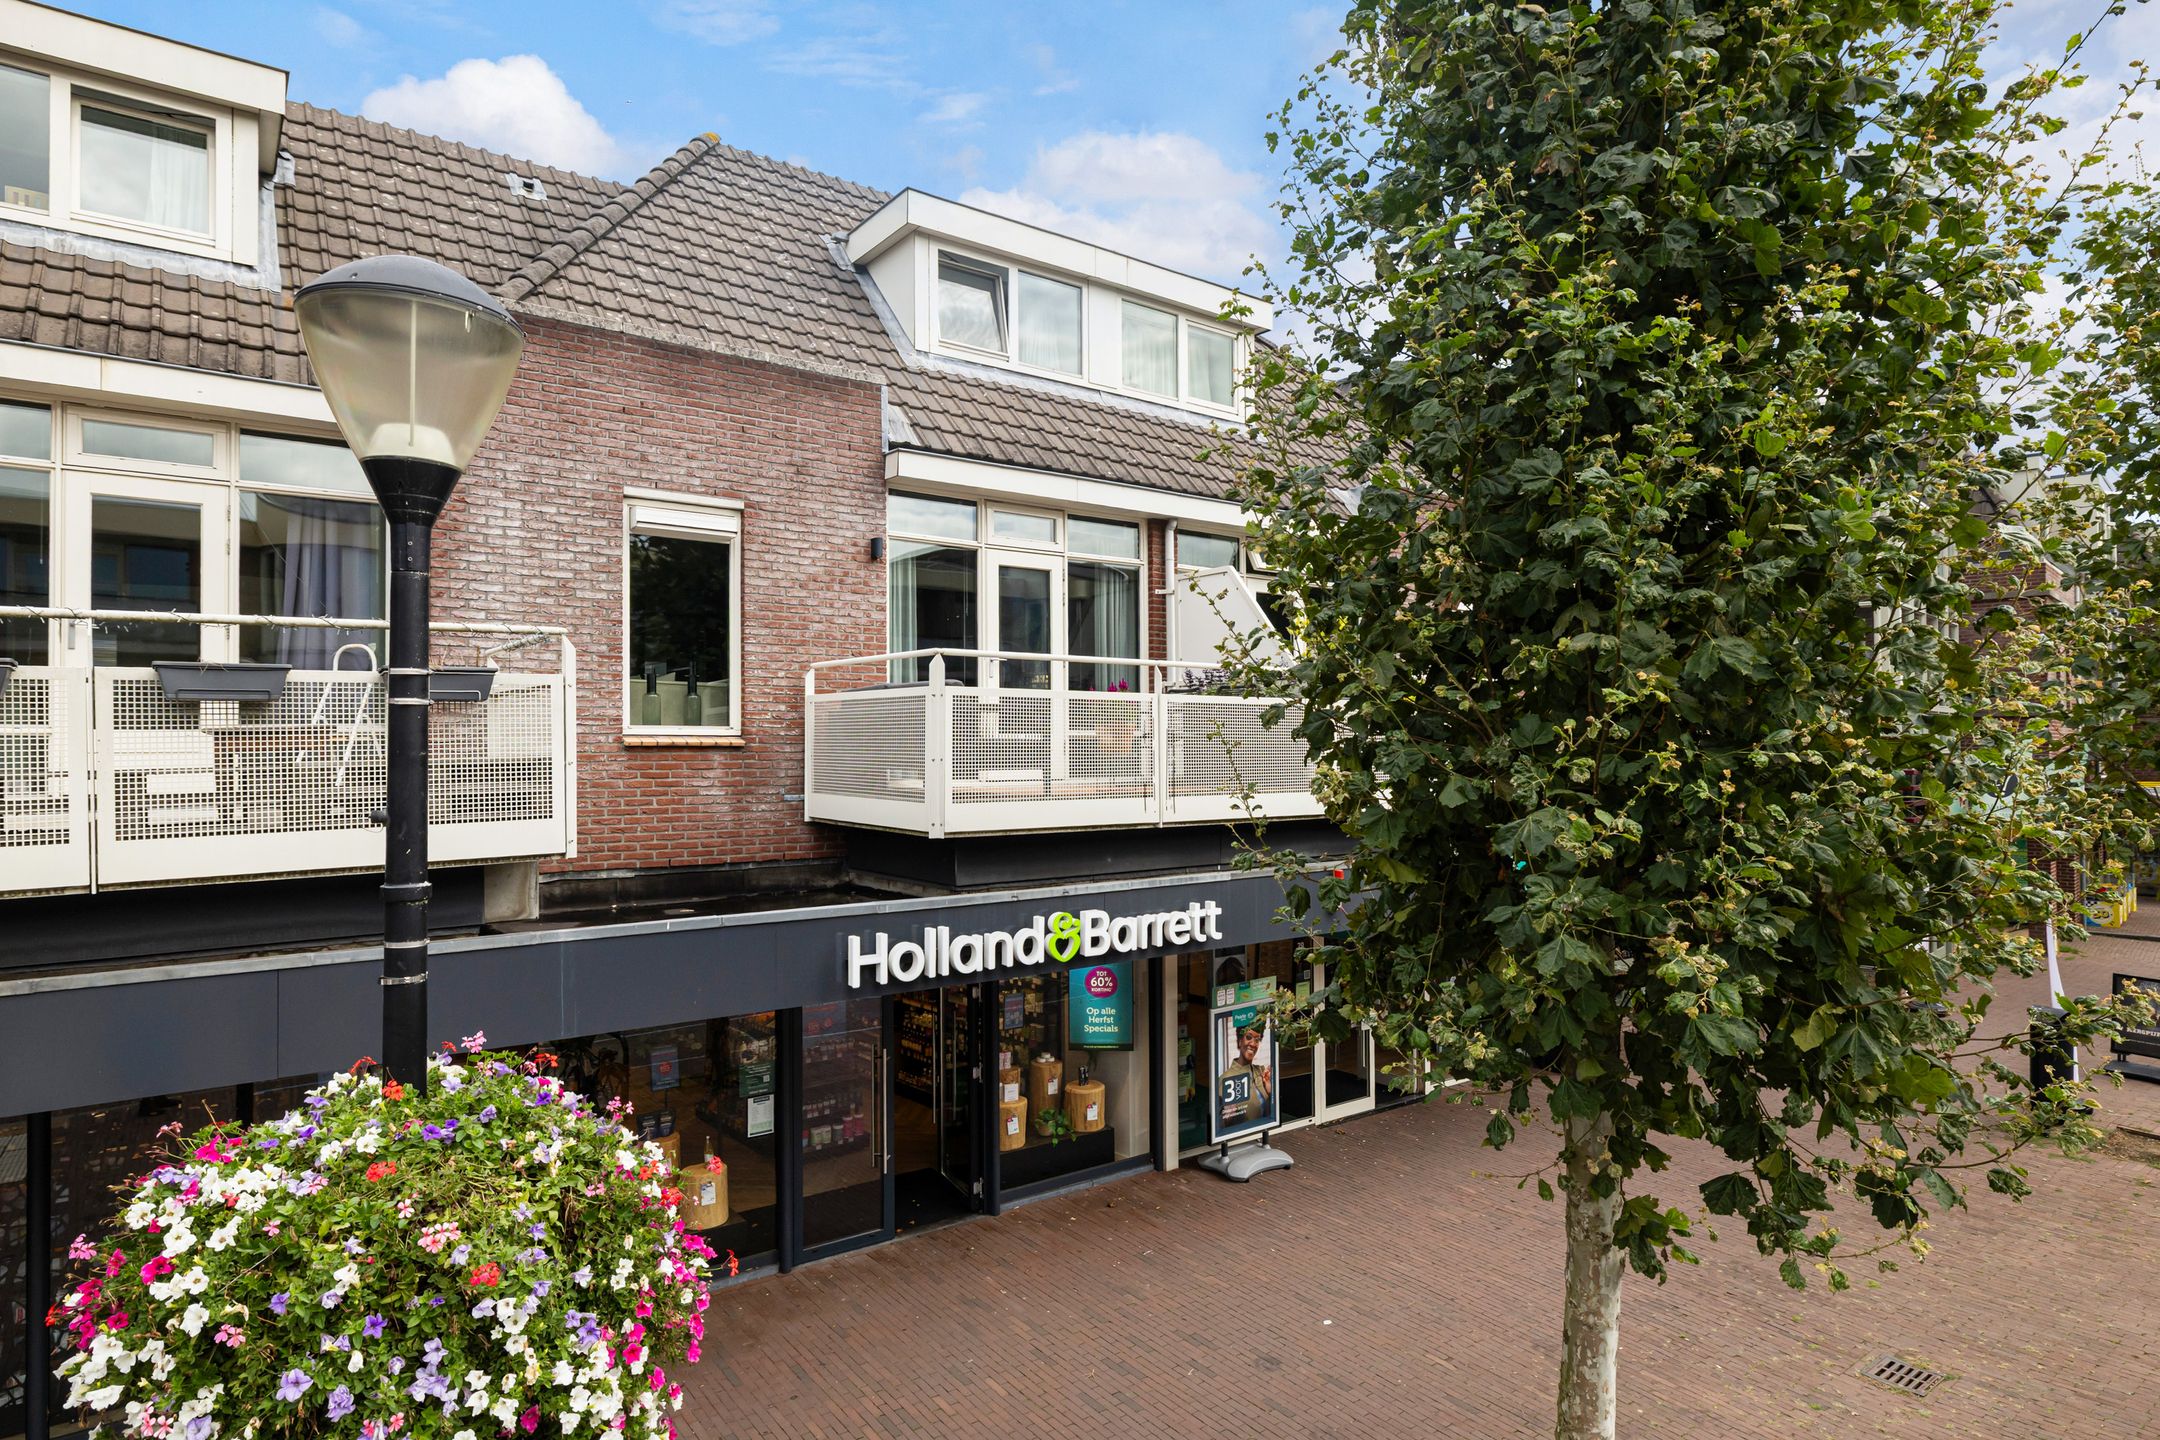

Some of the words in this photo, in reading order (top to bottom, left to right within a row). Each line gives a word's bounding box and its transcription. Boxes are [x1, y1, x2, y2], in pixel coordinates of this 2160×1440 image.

[1090, 977, 1113, 987] 60%
[1086, 1007, 1099, 1016] Op
[1101, 1007, 1116, 1015] alle
[1088, 1016, 1114, 1024] Herfst
[1084, 1024, 1119, 1033] Specials
[1224, 1079, 1235, 1102] 3
[1241, 1076, 1248, 1098] 1
